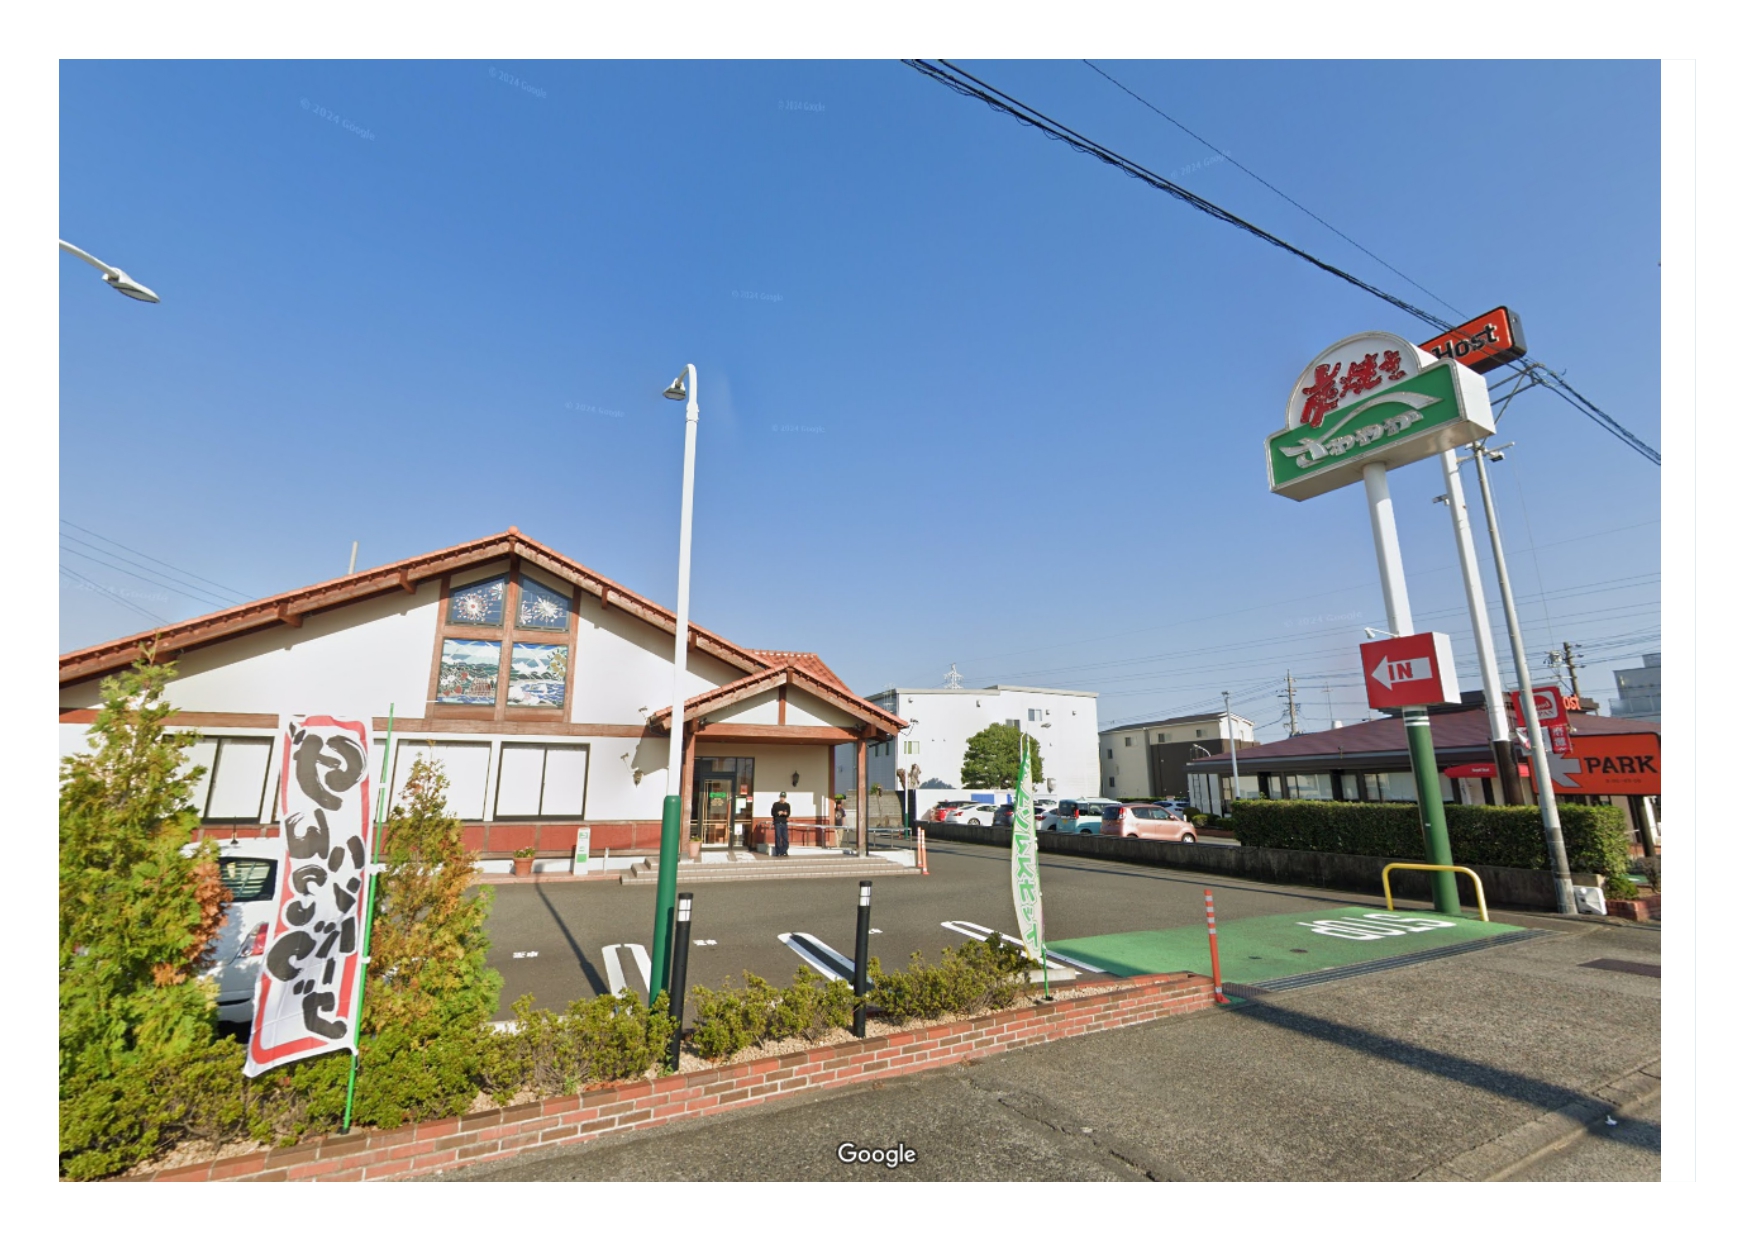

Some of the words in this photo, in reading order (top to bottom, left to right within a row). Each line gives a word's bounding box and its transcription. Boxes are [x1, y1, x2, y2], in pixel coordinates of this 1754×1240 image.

[1432, 323, 1499, 360] Host
[1300, 350, 1407, 428] 炭焼き
[1279, 392, 1443, 468] さわやか
[1388, 662, 1413, 680] IN
[1563, 694, 1580, 710] ost
[1583, 755, 1658, 774] PARK
